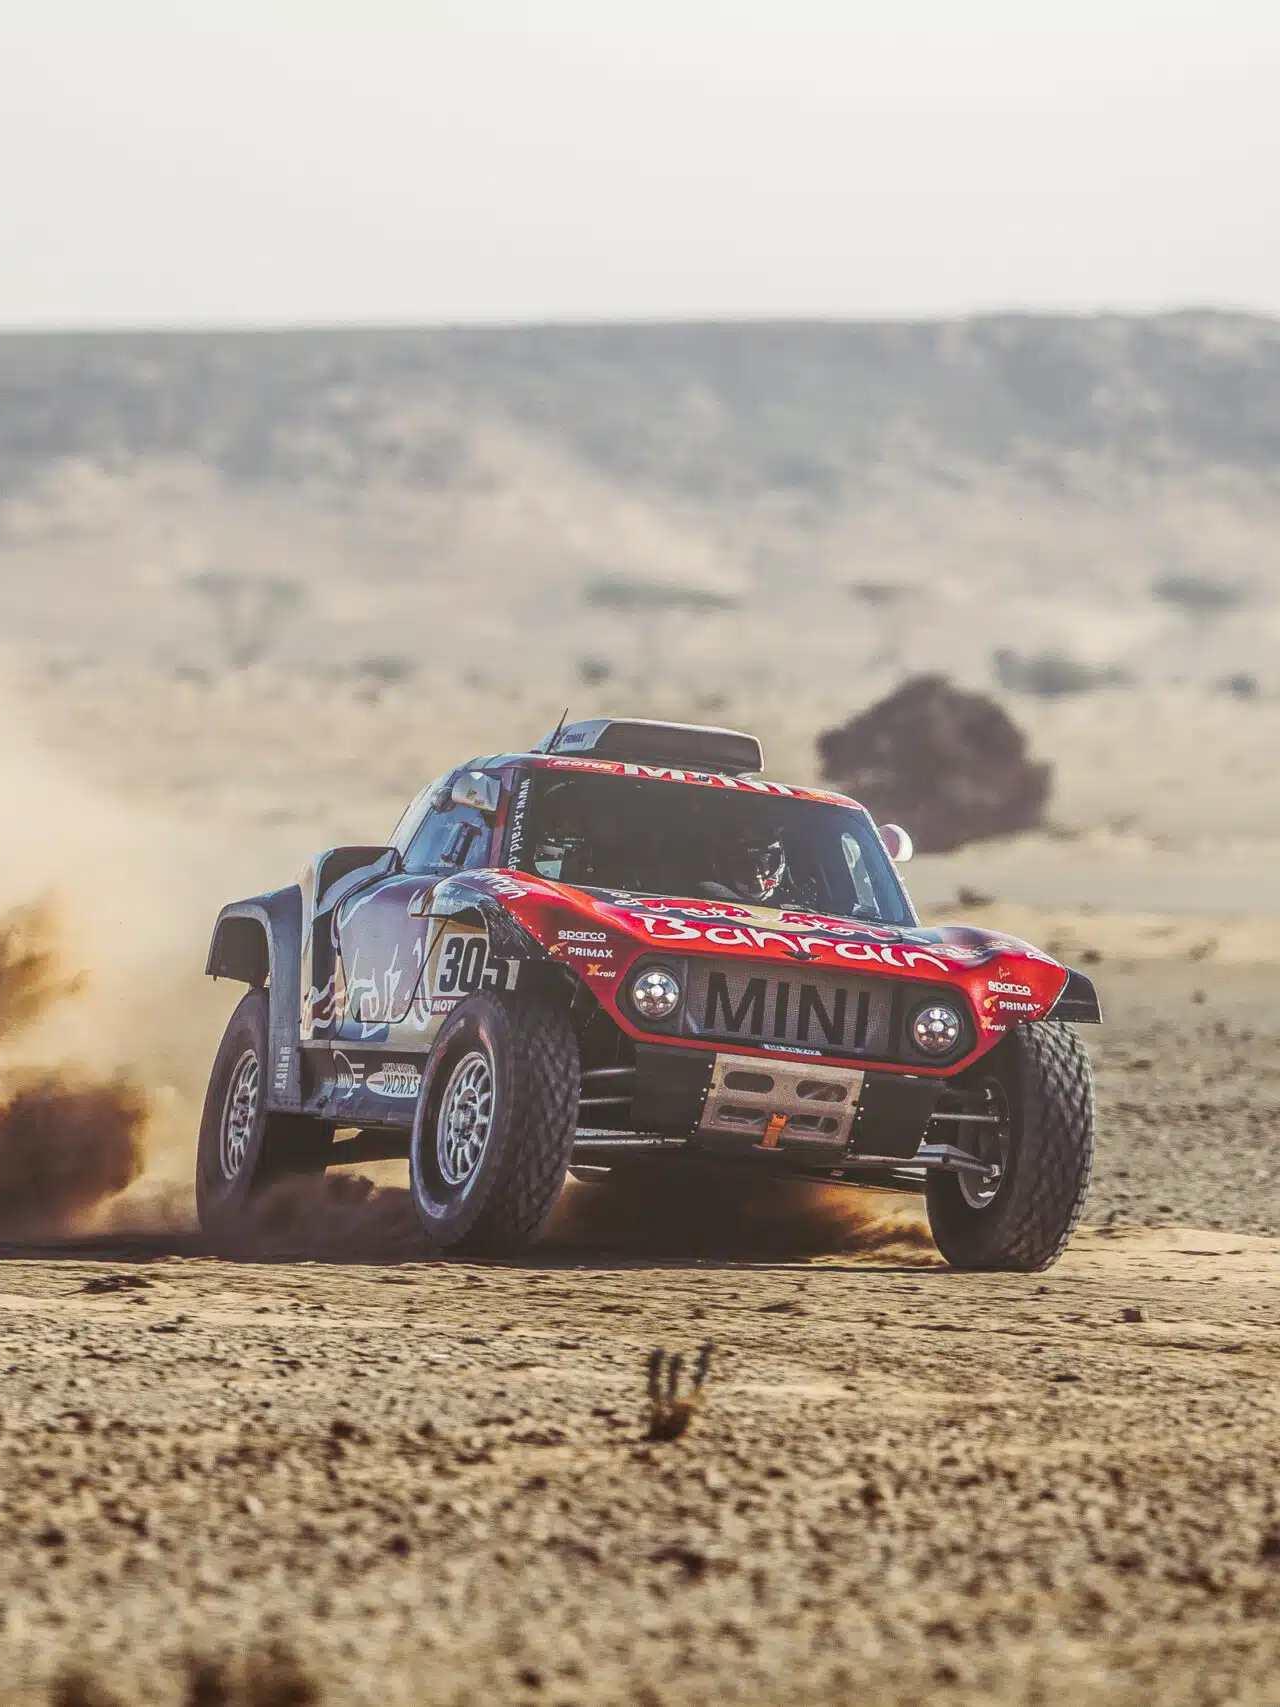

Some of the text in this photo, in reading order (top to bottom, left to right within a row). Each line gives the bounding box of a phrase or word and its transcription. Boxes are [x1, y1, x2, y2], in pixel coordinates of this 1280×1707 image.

[567, 946, 614, 958] PRIMAX
[630, 913, 949, 972] Bahrain
[704, 971, 870, 1048] MINI
[382, 1073, 419, 1095] WORKS
